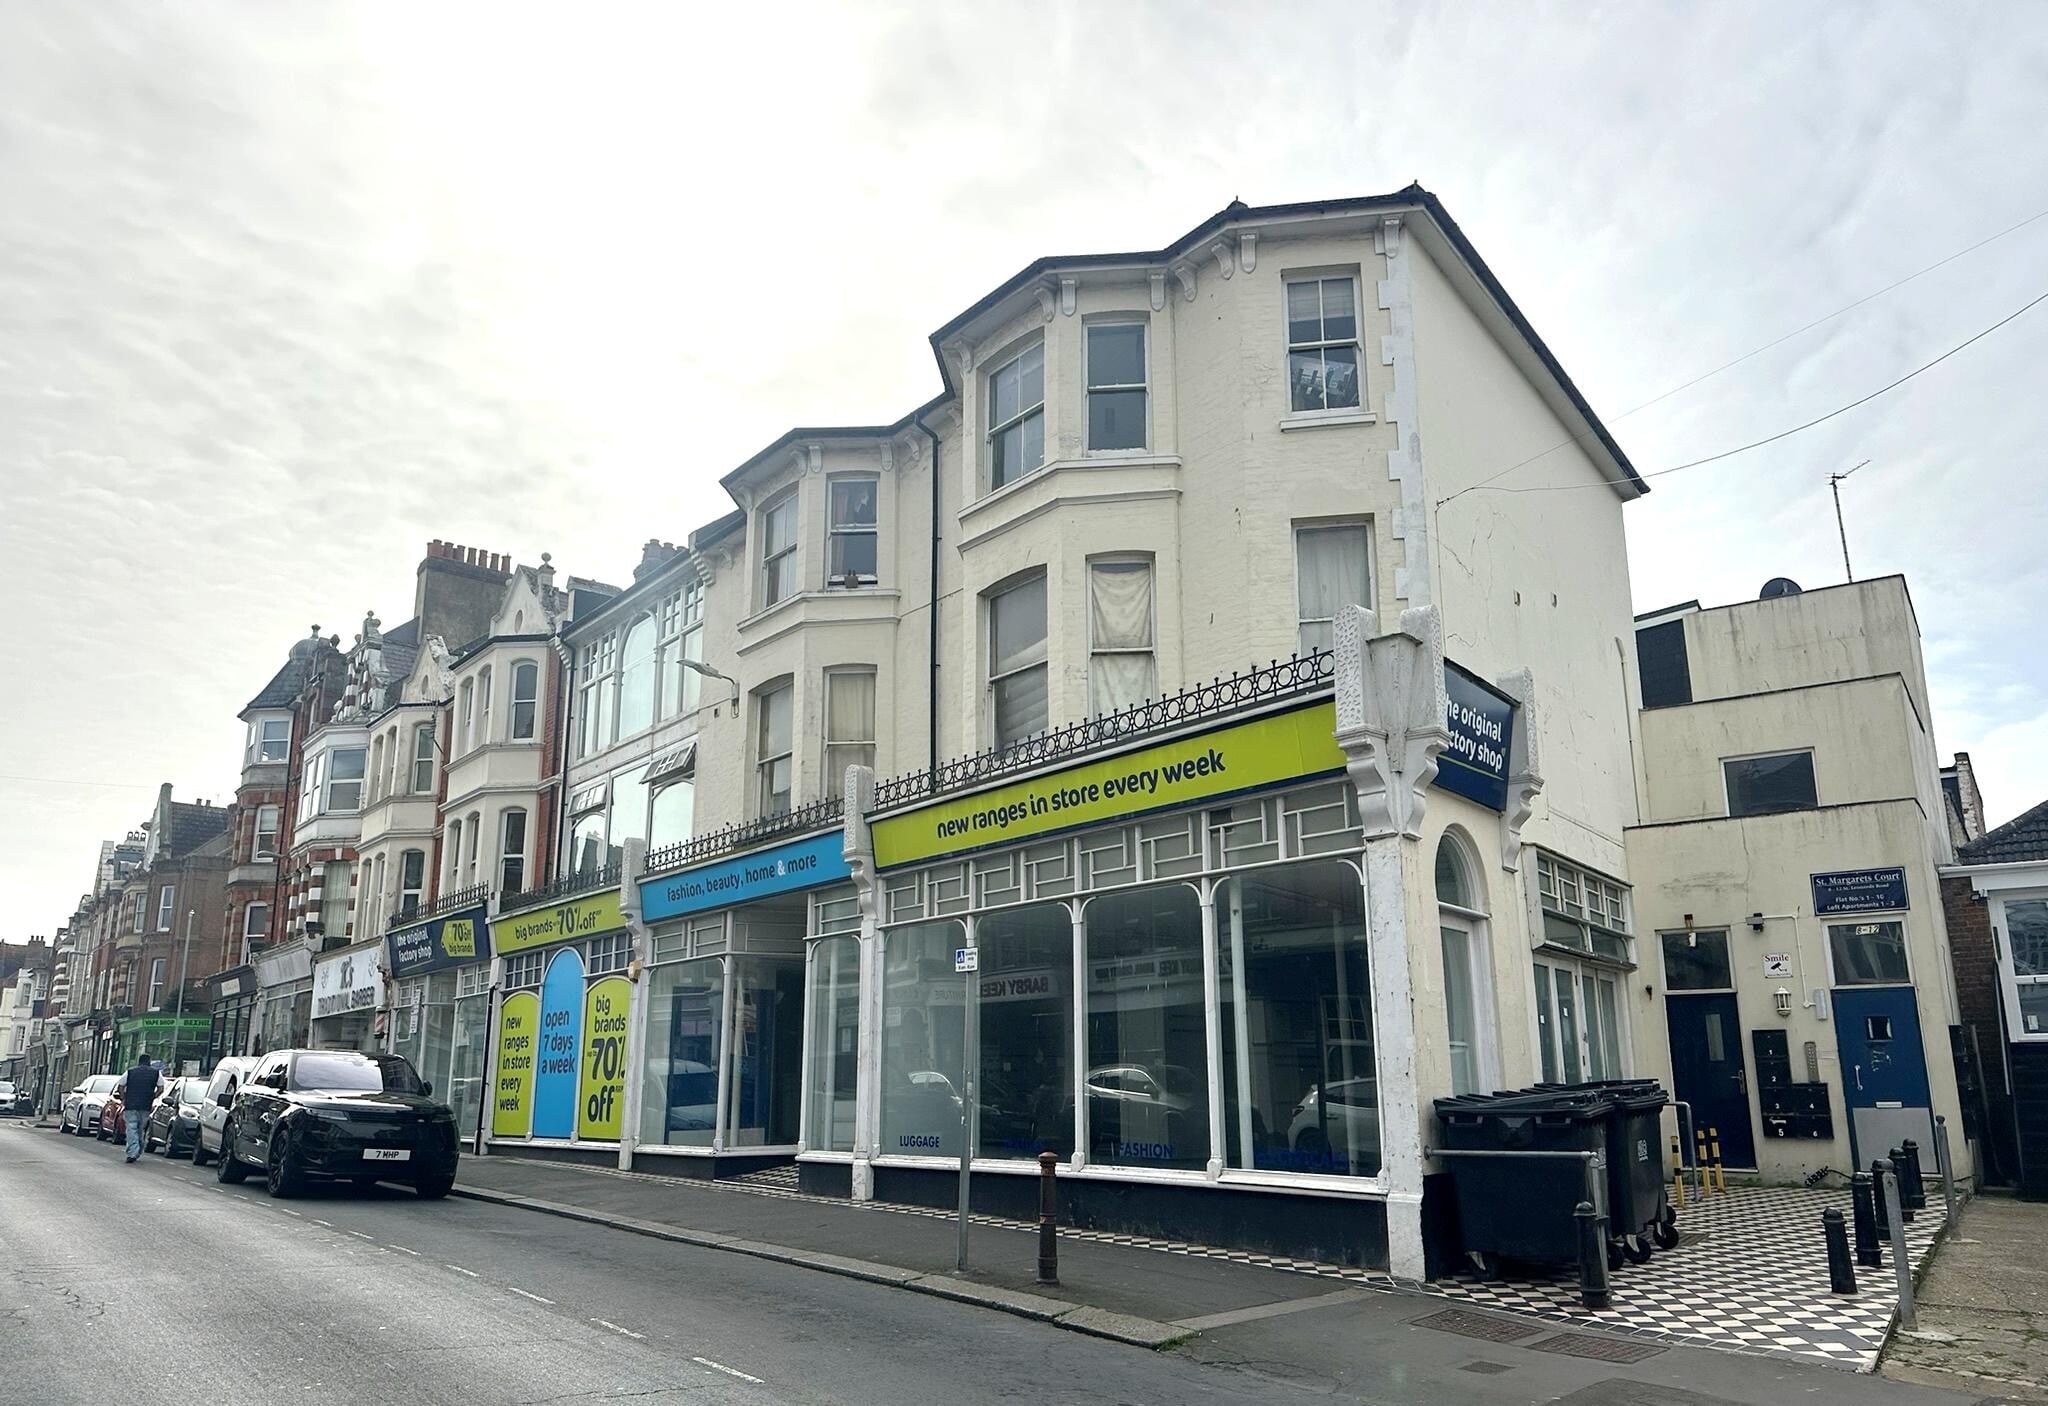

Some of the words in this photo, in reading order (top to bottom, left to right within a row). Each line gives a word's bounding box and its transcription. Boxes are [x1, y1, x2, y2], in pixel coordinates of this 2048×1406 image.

[1446, 693, 1459, 720] he
[1461, 707, 1502, 743] original
[1449, 730, 1476, 761] ctory
[1478, 742, 1503, 773] shop
[936, 815, 969, 839] new
[972, 802, 1027, 829] ranges
[1029, 794, 1048, 816] in
[1051, 783, 1100, 812] store
[1103, 768, 1159, 800] every
[1162, 748, 1226, 785] week
[666, 883, 705, 903] fashion,
[706, 873, 744, 893] beauty,
[745, 865, 776, 884] home
[777, 859, 786, 876] &
[787, 853, 817, 874] more
[1815, 878, 1828, 886] St.
[1829, 874, 1873, 886] Margarets
[1874, 872, 1900, 881] Court
[1841, 901, 1879, 910] Apartments
[515, 926, 528, 941] big
[528, 919, 553, 936] brands
[557, 906, 583, 935] 70%
[583, 911, 596, 929] off
[397, 934, 406, 947] the
[406, 926, 428, 945] original
[398, 948, 417, 962] factory
[418, 944, 432, 959] shop
[449, 944, 457, 954] big
[457, 944, 473, 953] brands
[1765, 954, 1790, 962] Smile
[596, 994, 610, 1016] big
[505, 1016, 522, 1030] new
[545, 1010, 570, 1031] open
[594, 1013, 626, 1033] brands
[504, 1035, 529, 1052] ranges
[544, 1034, 550, 1052] 7
[551, 1032, 573, 1055] days
[502, 1054, 511, 1070] in
[511, 1055, 531, 1070] store
[541, 1060, 547, 1074] a
[549, 1054, 575, 1074] week
[591, 1036, 626, 1081] 70%
[501, 1077, 522, 1093] every
[499, 1095, 520, 1111] week
[587, 1085, 615, 1122] off
[1778, 1128, 1784, 1137] 5
[899, 1135, 940, 1149] LUGGAGE
[1119, 1142, 1173, 1158] FASHION
[376, 1150, 382, 1158] 7
